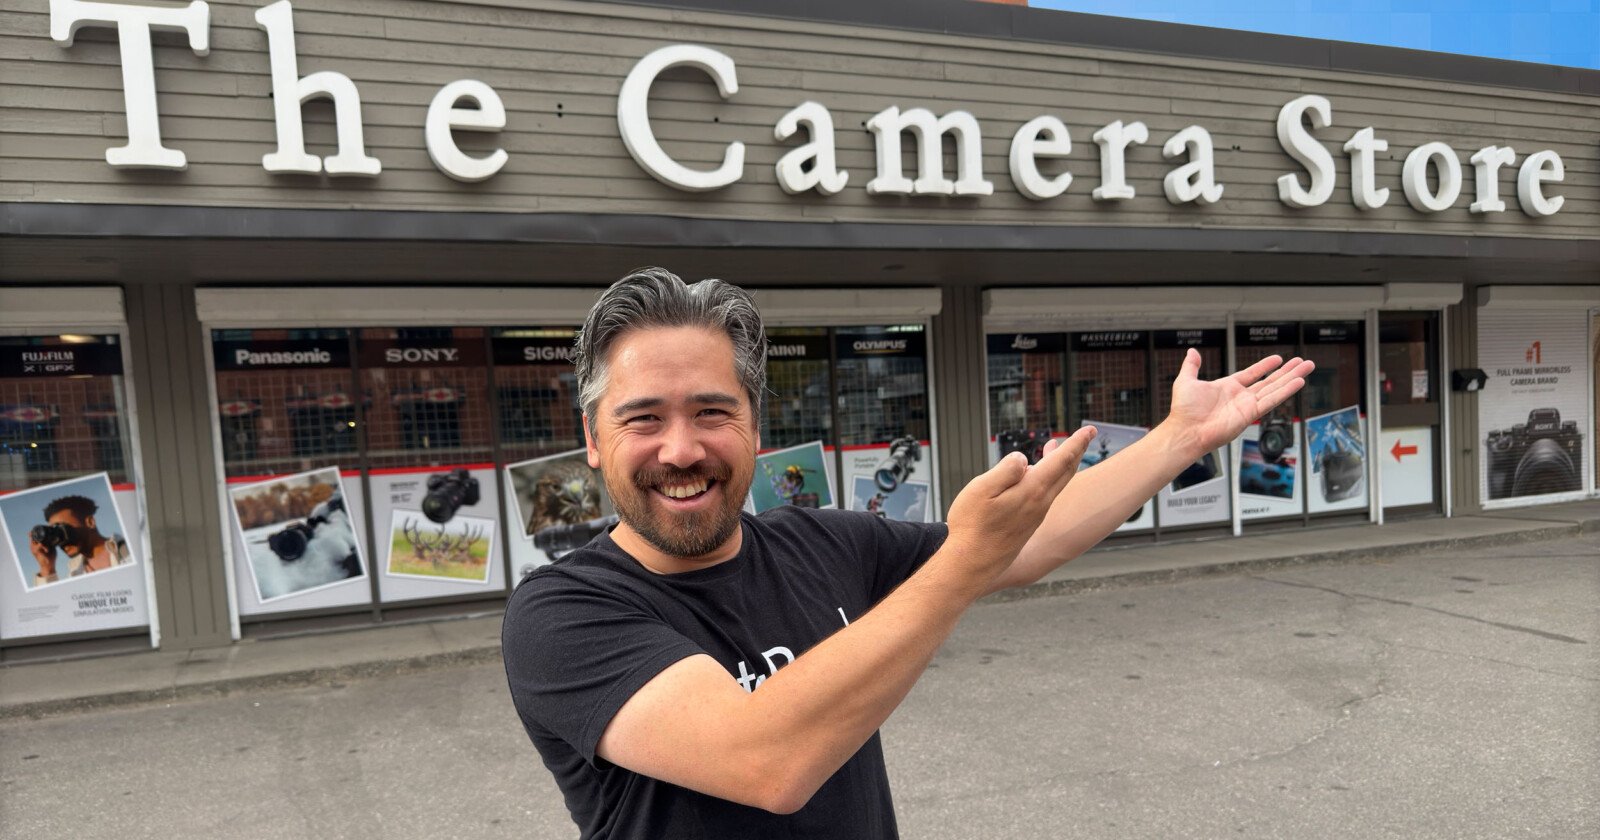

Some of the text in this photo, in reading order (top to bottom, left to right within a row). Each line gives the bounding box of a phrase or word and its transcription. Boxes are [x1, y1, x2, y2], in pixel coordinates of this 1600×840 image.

[49, 0, 1566, 216] The Camera Store
[1248, 327, 1278, 336] RICOH
[767, 343, 806, 357] anon
[853, 340, 907, 350] OLYMPUS
[22, 351, 74, 361] FUJIFILM
[235, 347, 331, 365] Panasonic
[385, 348, 459, 362] SONY
[1525, 341, 1541, 365] #1
[1496, 366, 1572, 377] FULL FRAME MIRRORLESS
[1510, 376, 1559, 386] CAMERA BRAND
[78, 596, 128, 609] UNIQUE FILM
